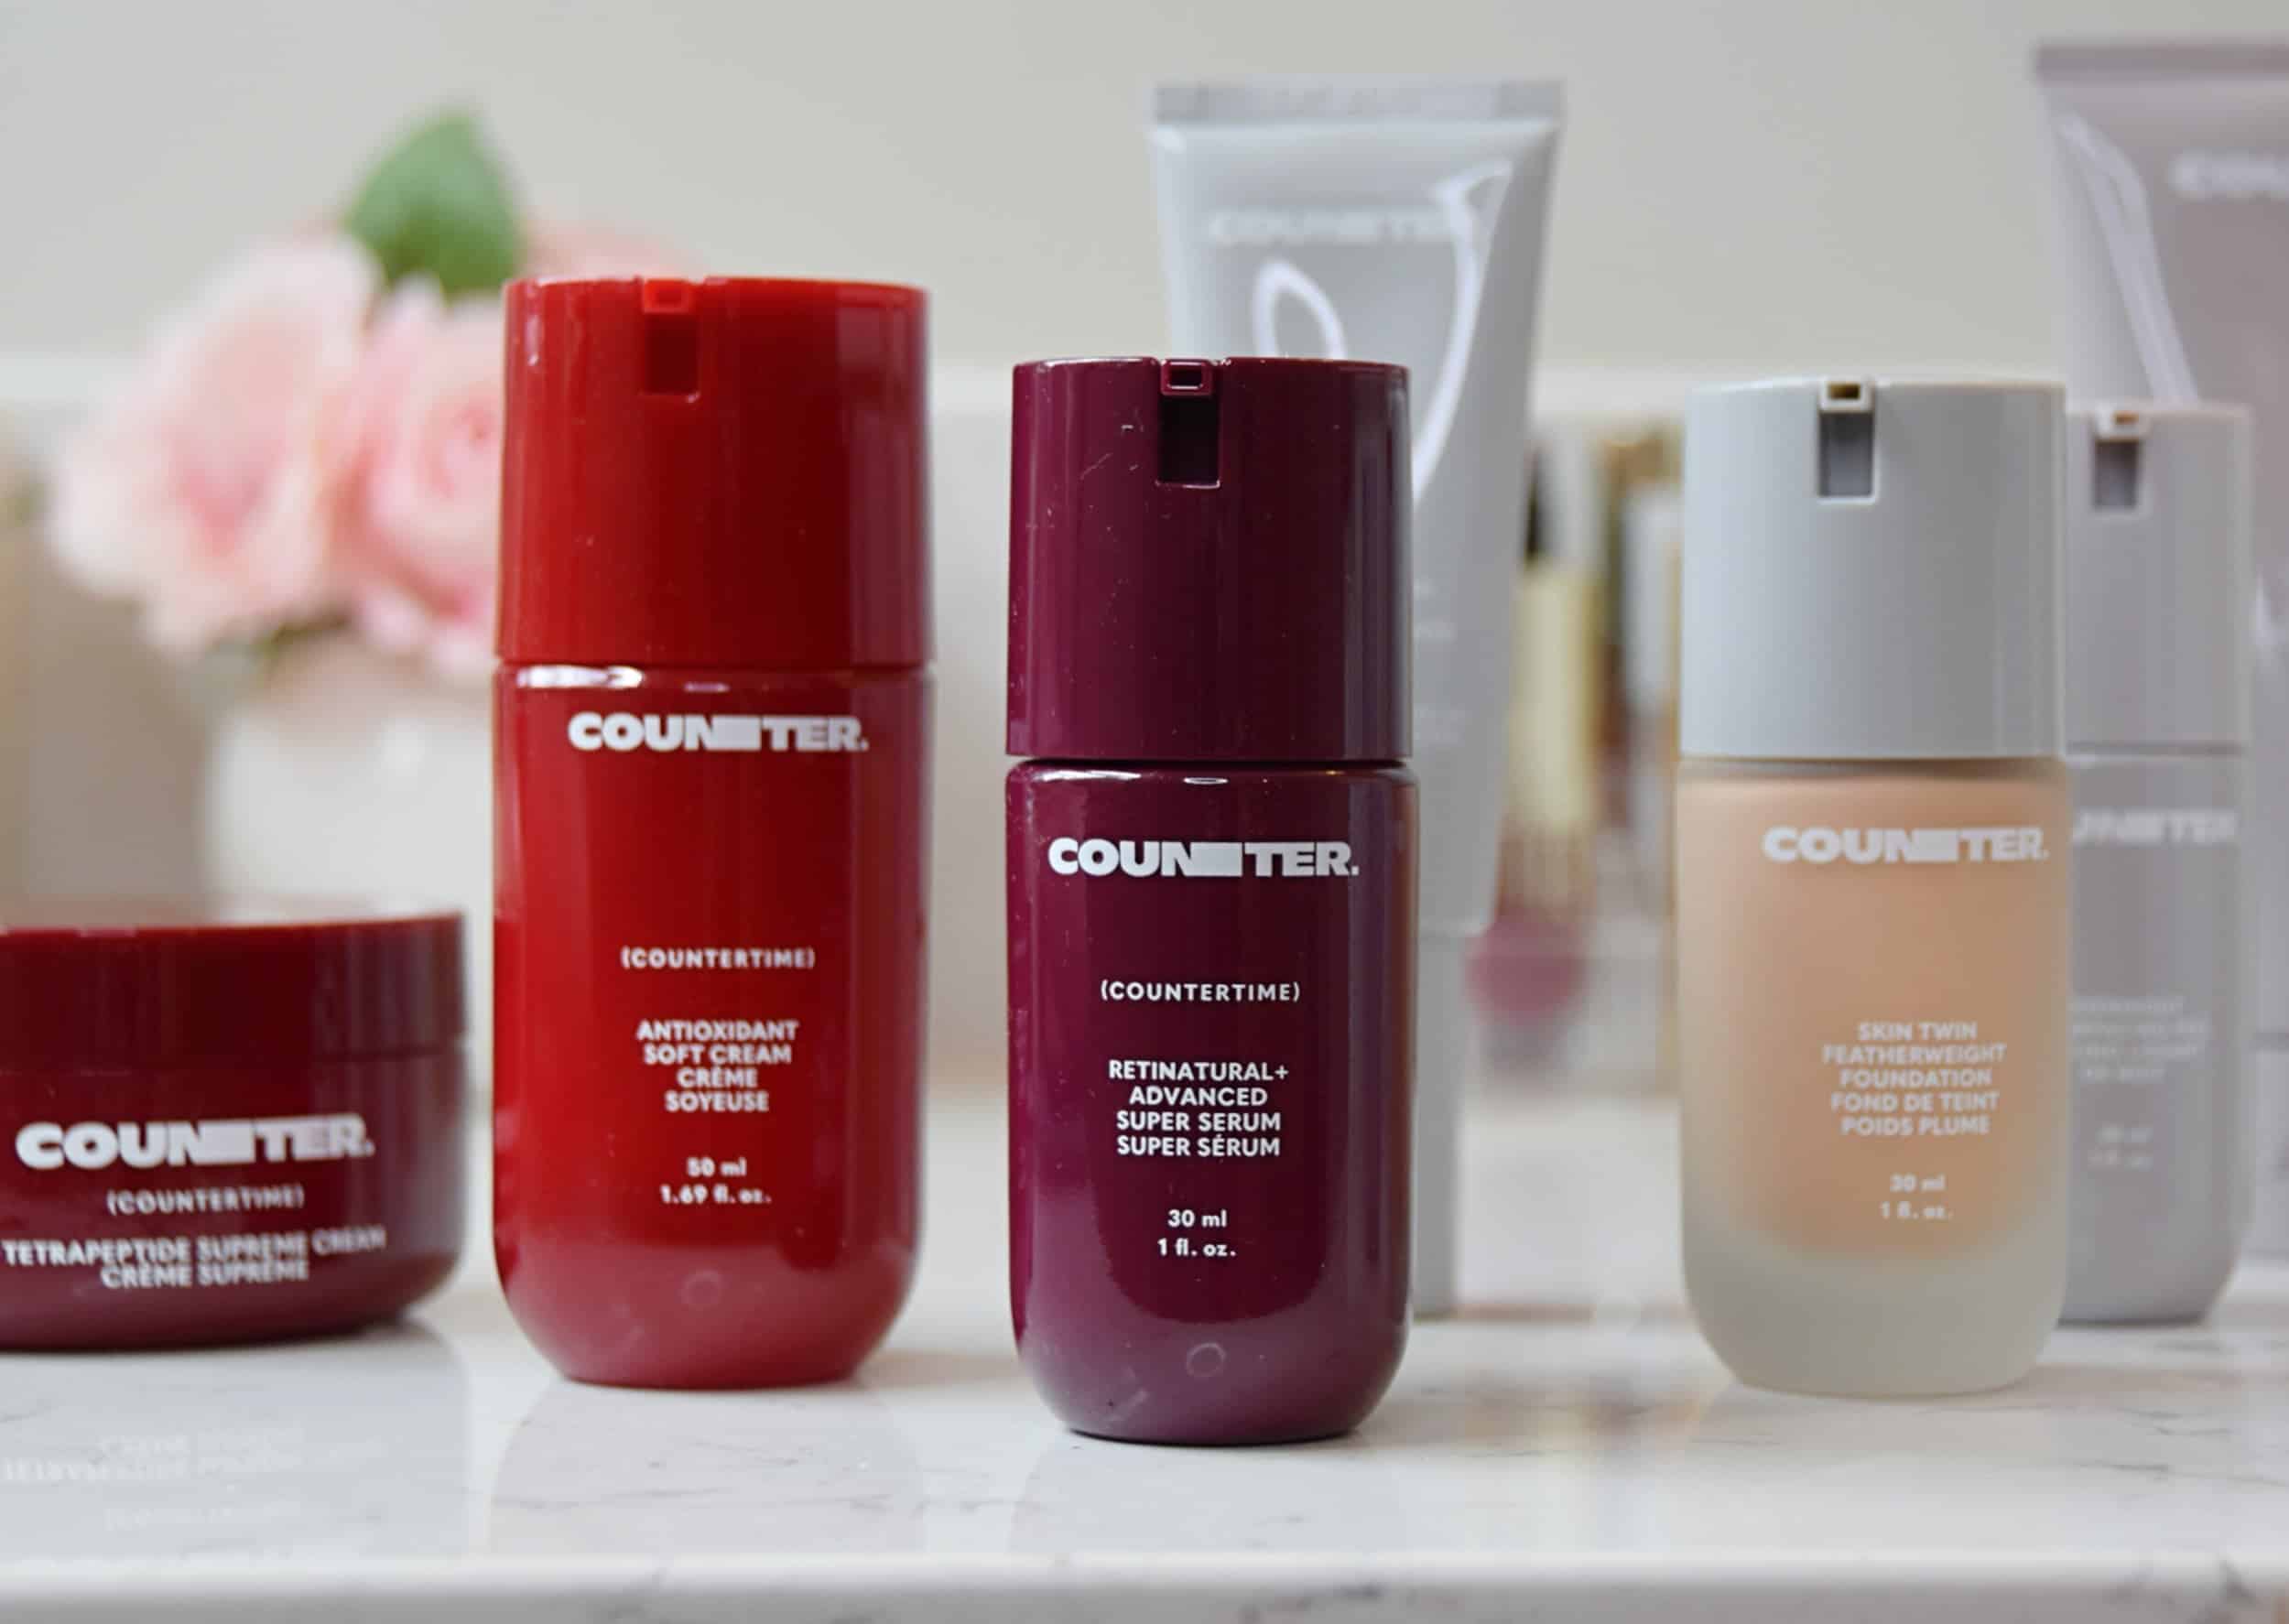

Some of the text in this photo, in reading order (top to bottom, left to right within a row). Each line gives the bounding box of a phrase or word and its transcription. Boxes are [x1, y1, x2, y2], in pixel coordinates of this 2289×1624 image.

[567, 711, 868, 752] COUNTER.
[1762, 826, 2049, 863] COUNTER.
[1047, 837, 1360, 877] COUNTER.
[620, 947, 816, 969] (COUNTERTIME)
[1101, 979, 1300, 1001] (COUNTERTIME)
[636, 1020, 798, 1042] ANTIOXIDANT
[1859, 1022, 1978, 1041] SKIN TWIN
[644, 1044, 793, 1065] SOFT CREAM
[1822, 1043, 2008, 1065] FEATHERWEIGHT
[1109, 1059, 1288, 1081] RETINATURAL+
[1839, 1067, 1992, 1088] FOUNDATION
[665, 1090, 768, 1112] SOYEUSE
[1129, 1085, 1268, 1107] ADVANCED
[1830, 1090, 2001, 1113] FOND DE TEINT
[1116, 1110, 1282, 1131] SUPER SERUM
[1840, 1114, 1991, 1136] POIDS PLUME
[15, 1114, 374, 1169] COUNTER.
[1117, 1133, 1281, 1157] SUPER SÉRUM
[687, 1156, 747, 1177] 50 ml
[660, 1184, 708, 1204] 1.69
[1889, 1174, 1946, 1193] 30 ml
[105, 1186, 304, 1216] (COUNTERTIME)
[1880, 1200, 1891, 1218] 1
[1167, 1208, 1227, 1228] 30 ml
[1, 1227, 386, 1267] TETRAPEPTIDE SUPREME CREAM
[1157, 1237, 1236, 1257] 1 fl. oz.
